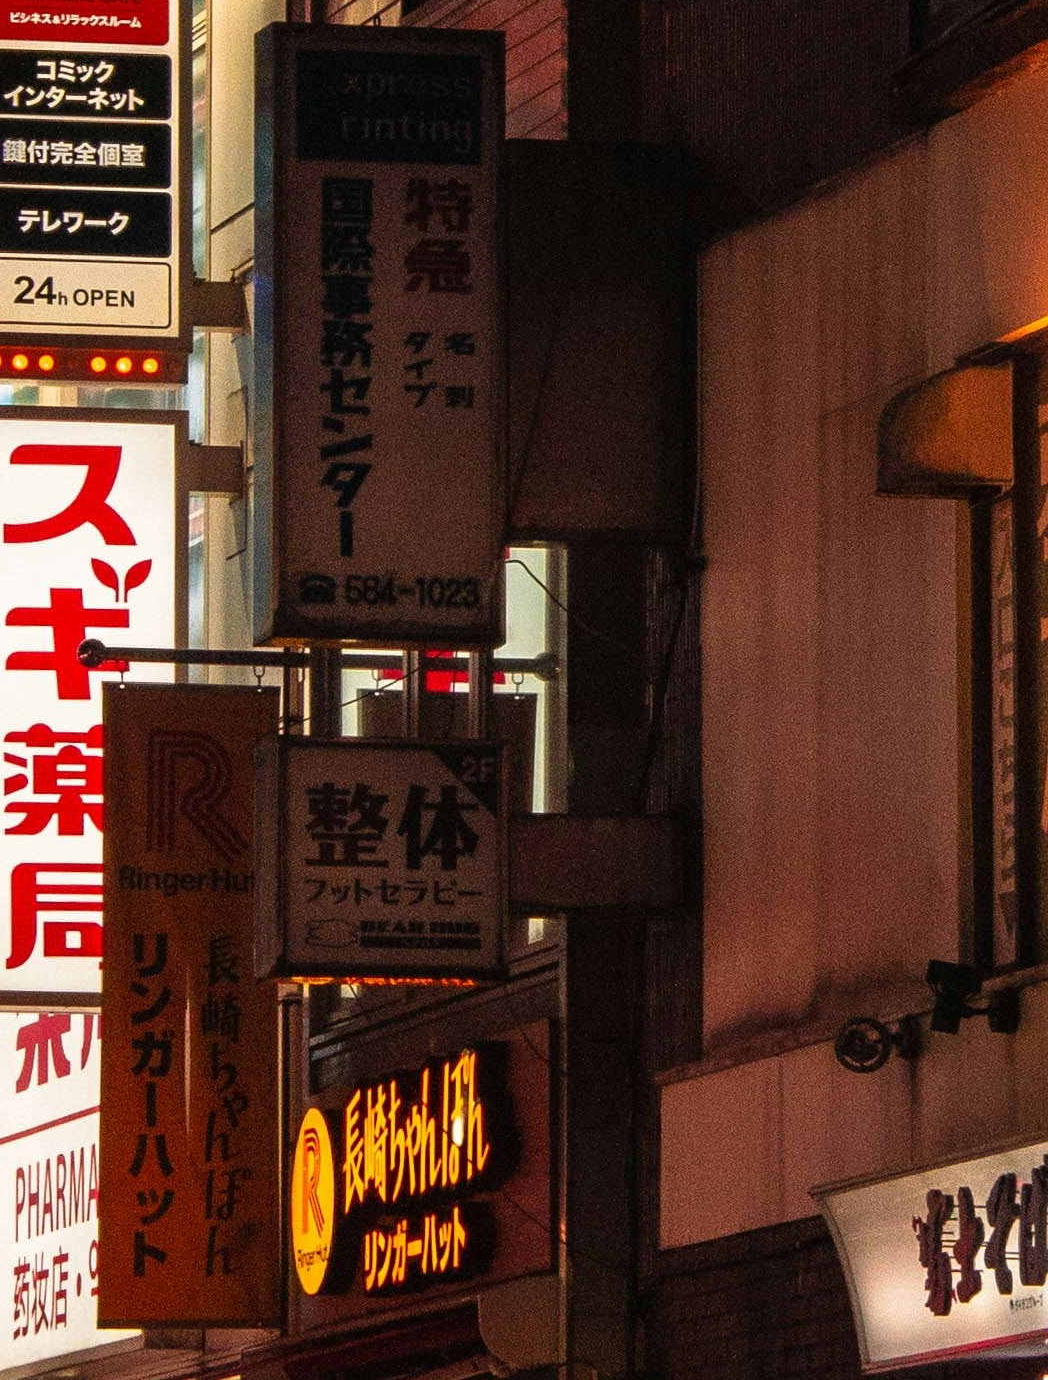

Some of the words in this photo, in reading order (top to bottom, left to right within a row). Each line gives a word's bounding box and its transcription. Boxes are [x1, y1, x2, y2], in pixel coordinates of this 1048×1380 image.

[3, 85, 145, 112] インターネット
[35, 60, 115, 83] コミック
[2, 138, 146, 168] 鍵付完全個室
[17, 209, 130, 235] テレワーク
[404, 178, 472, 295] 特急
[13, 275, 69, 306] 24h
[73, 288, 136, 308] OPEN
[320, 177, 373, 558] 国際事務センター
[404, 331, 436, 409] タイプ
[345, 574, 480, 609] 584-1023
[3, 443, 152, 970] スギ薬局
[305, 782, 480, 871] 整体
[305, 878, 482, 906] フットセラピー
[129, 931, 173, 1279] リンガーハット
[199, 933, 250, 1279] 長崎ちゃんぽん
[343, 1051, 491, 1215] 長崎ちゃんぽん
[364, 1205, 467, 1292] リンガーハット
